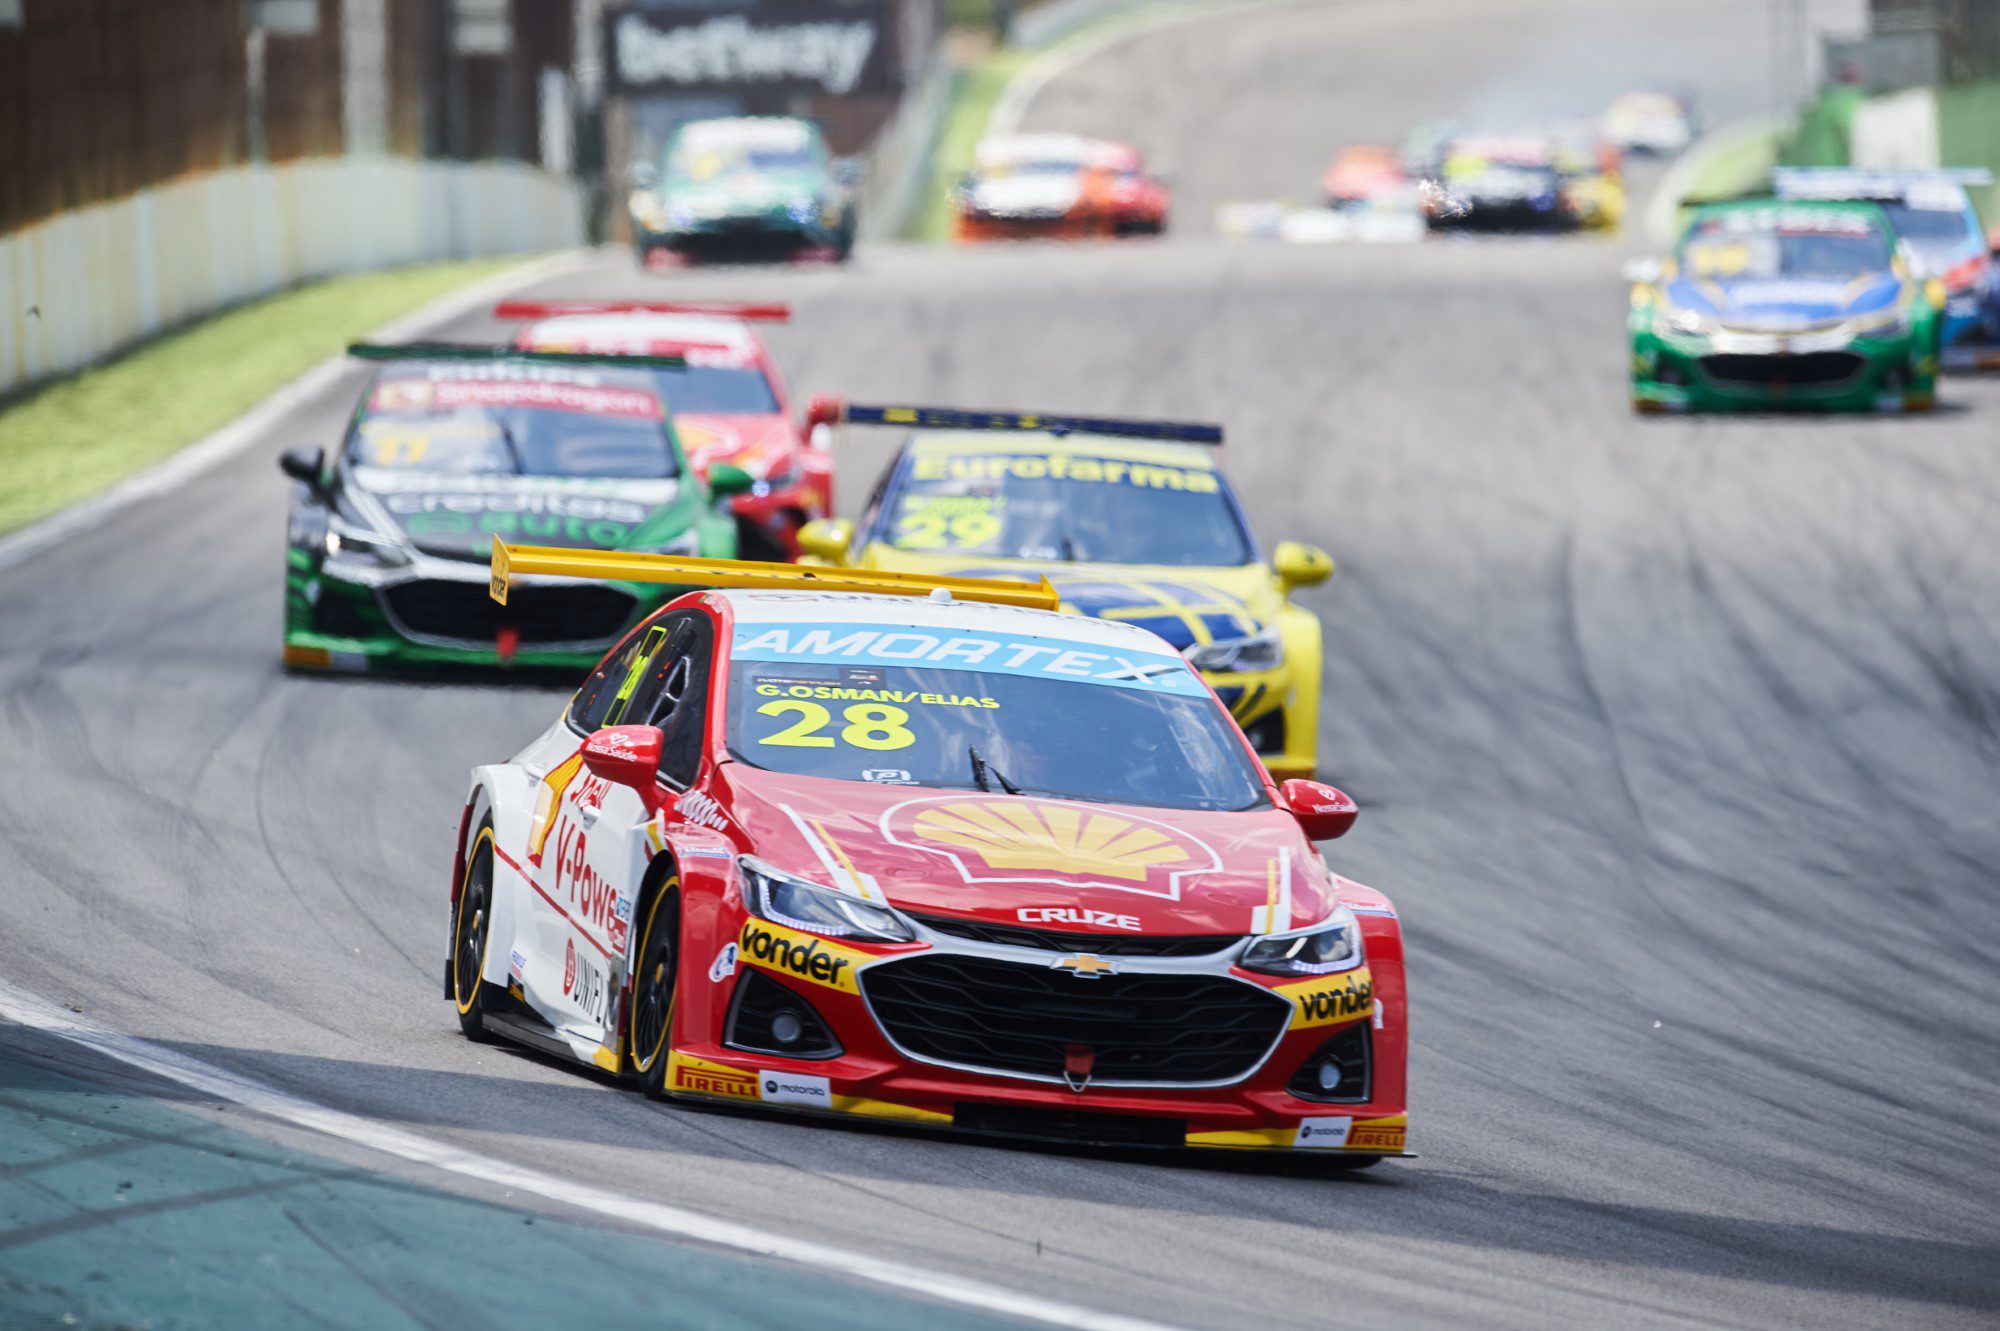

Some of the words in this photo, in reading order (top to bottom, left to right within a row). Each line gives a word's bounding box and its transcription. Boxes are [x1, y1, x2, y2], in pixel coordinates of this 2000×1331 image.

[912, 453, 1220, 494] Eurofarma
[896, 512, 1001, 549] 29
[734, 629, 1174, 686] AMORTEX
[756, 699, 917, 750] 28
[1016, 907, 1143, 932] CRUZE
[742, 923, 849, 985] vonder
[675, 1064, 759, 1097] PIRELLI
[780, 1083, 826, 1097] motorola
[1344, 1124, 1407, 1148] PIRELLI
